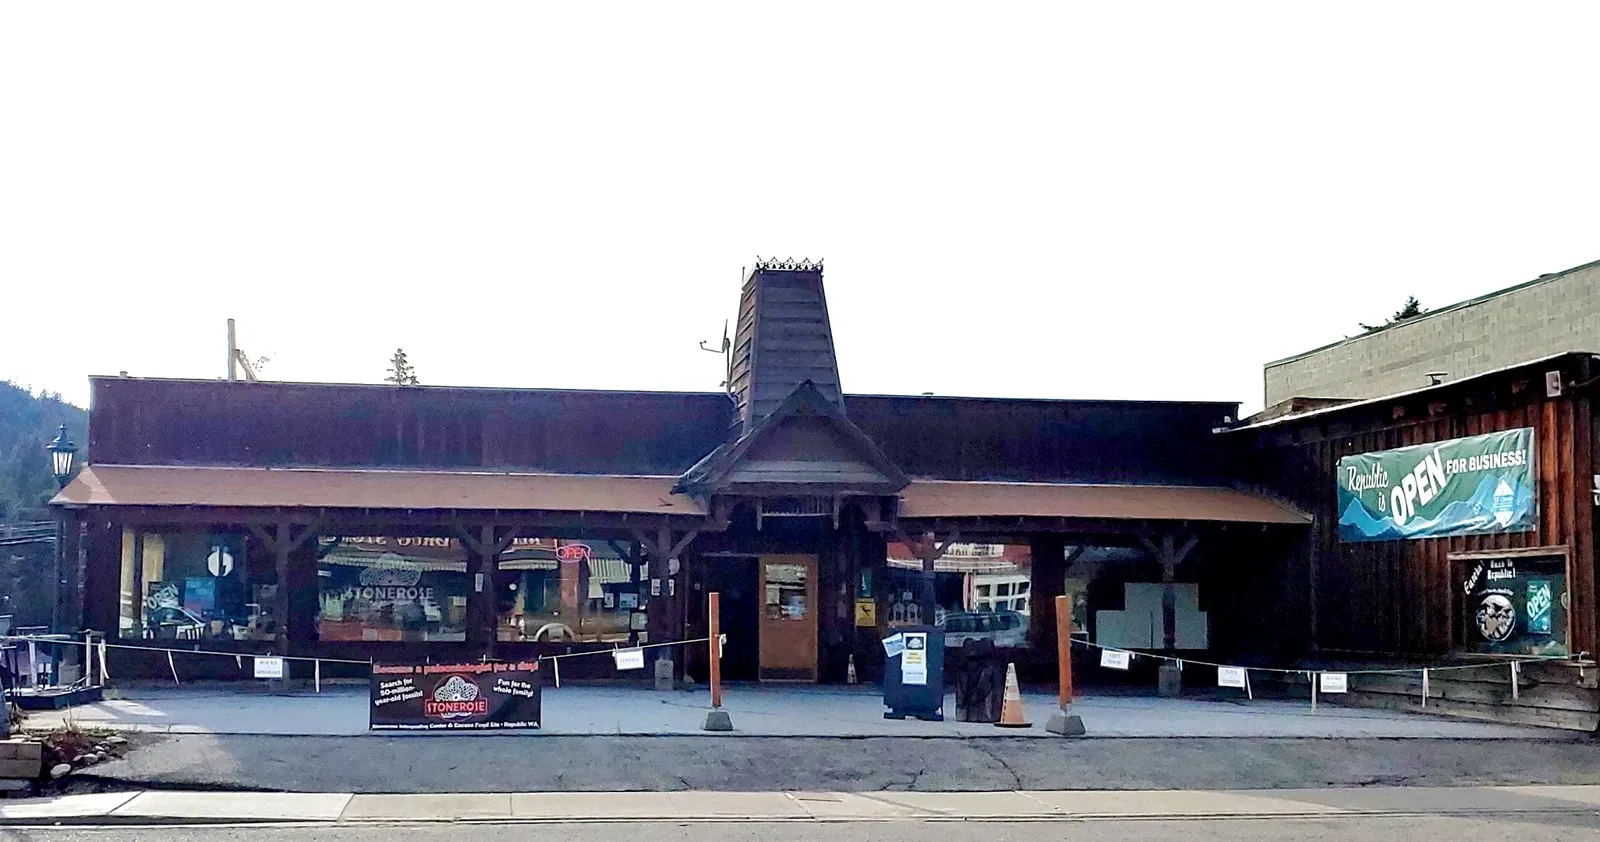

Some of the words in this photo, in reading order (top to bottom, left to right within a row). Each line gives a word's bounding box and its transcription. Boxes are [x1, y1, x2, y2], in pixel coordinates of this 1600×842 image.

[1446, 456, 1467, 475] FOR
[1468, 449, 1527, 472] BUSINESS!
[1347, 461, 1389, 498] Republic
[1390, 447, 1448, 527] OPEN
[1378, 491, 1386, 512] is
[556, 547, 591, 559] OPEN
[147, 583, 180, 610] OPEN
[347, 587, 434, 600] STONEROSE
[1527, 583, 1551, 618] OPEN
[493, 662, 508, 674] for
[509, 663, 516, 671] a
[380, 679, 403, 689] Search
[403, 678, 413, 686] for
[497, 678, 511, 686] Fun
[511, 680, 521, 688] for
[380, 685, 416, 696] 50-million-
[493, 686, 512, 694] whole
[512, 688, 534, 698] family!
[374, 694, 402, 706] year-old
[427, 701, 485, 713] STONEROSE
